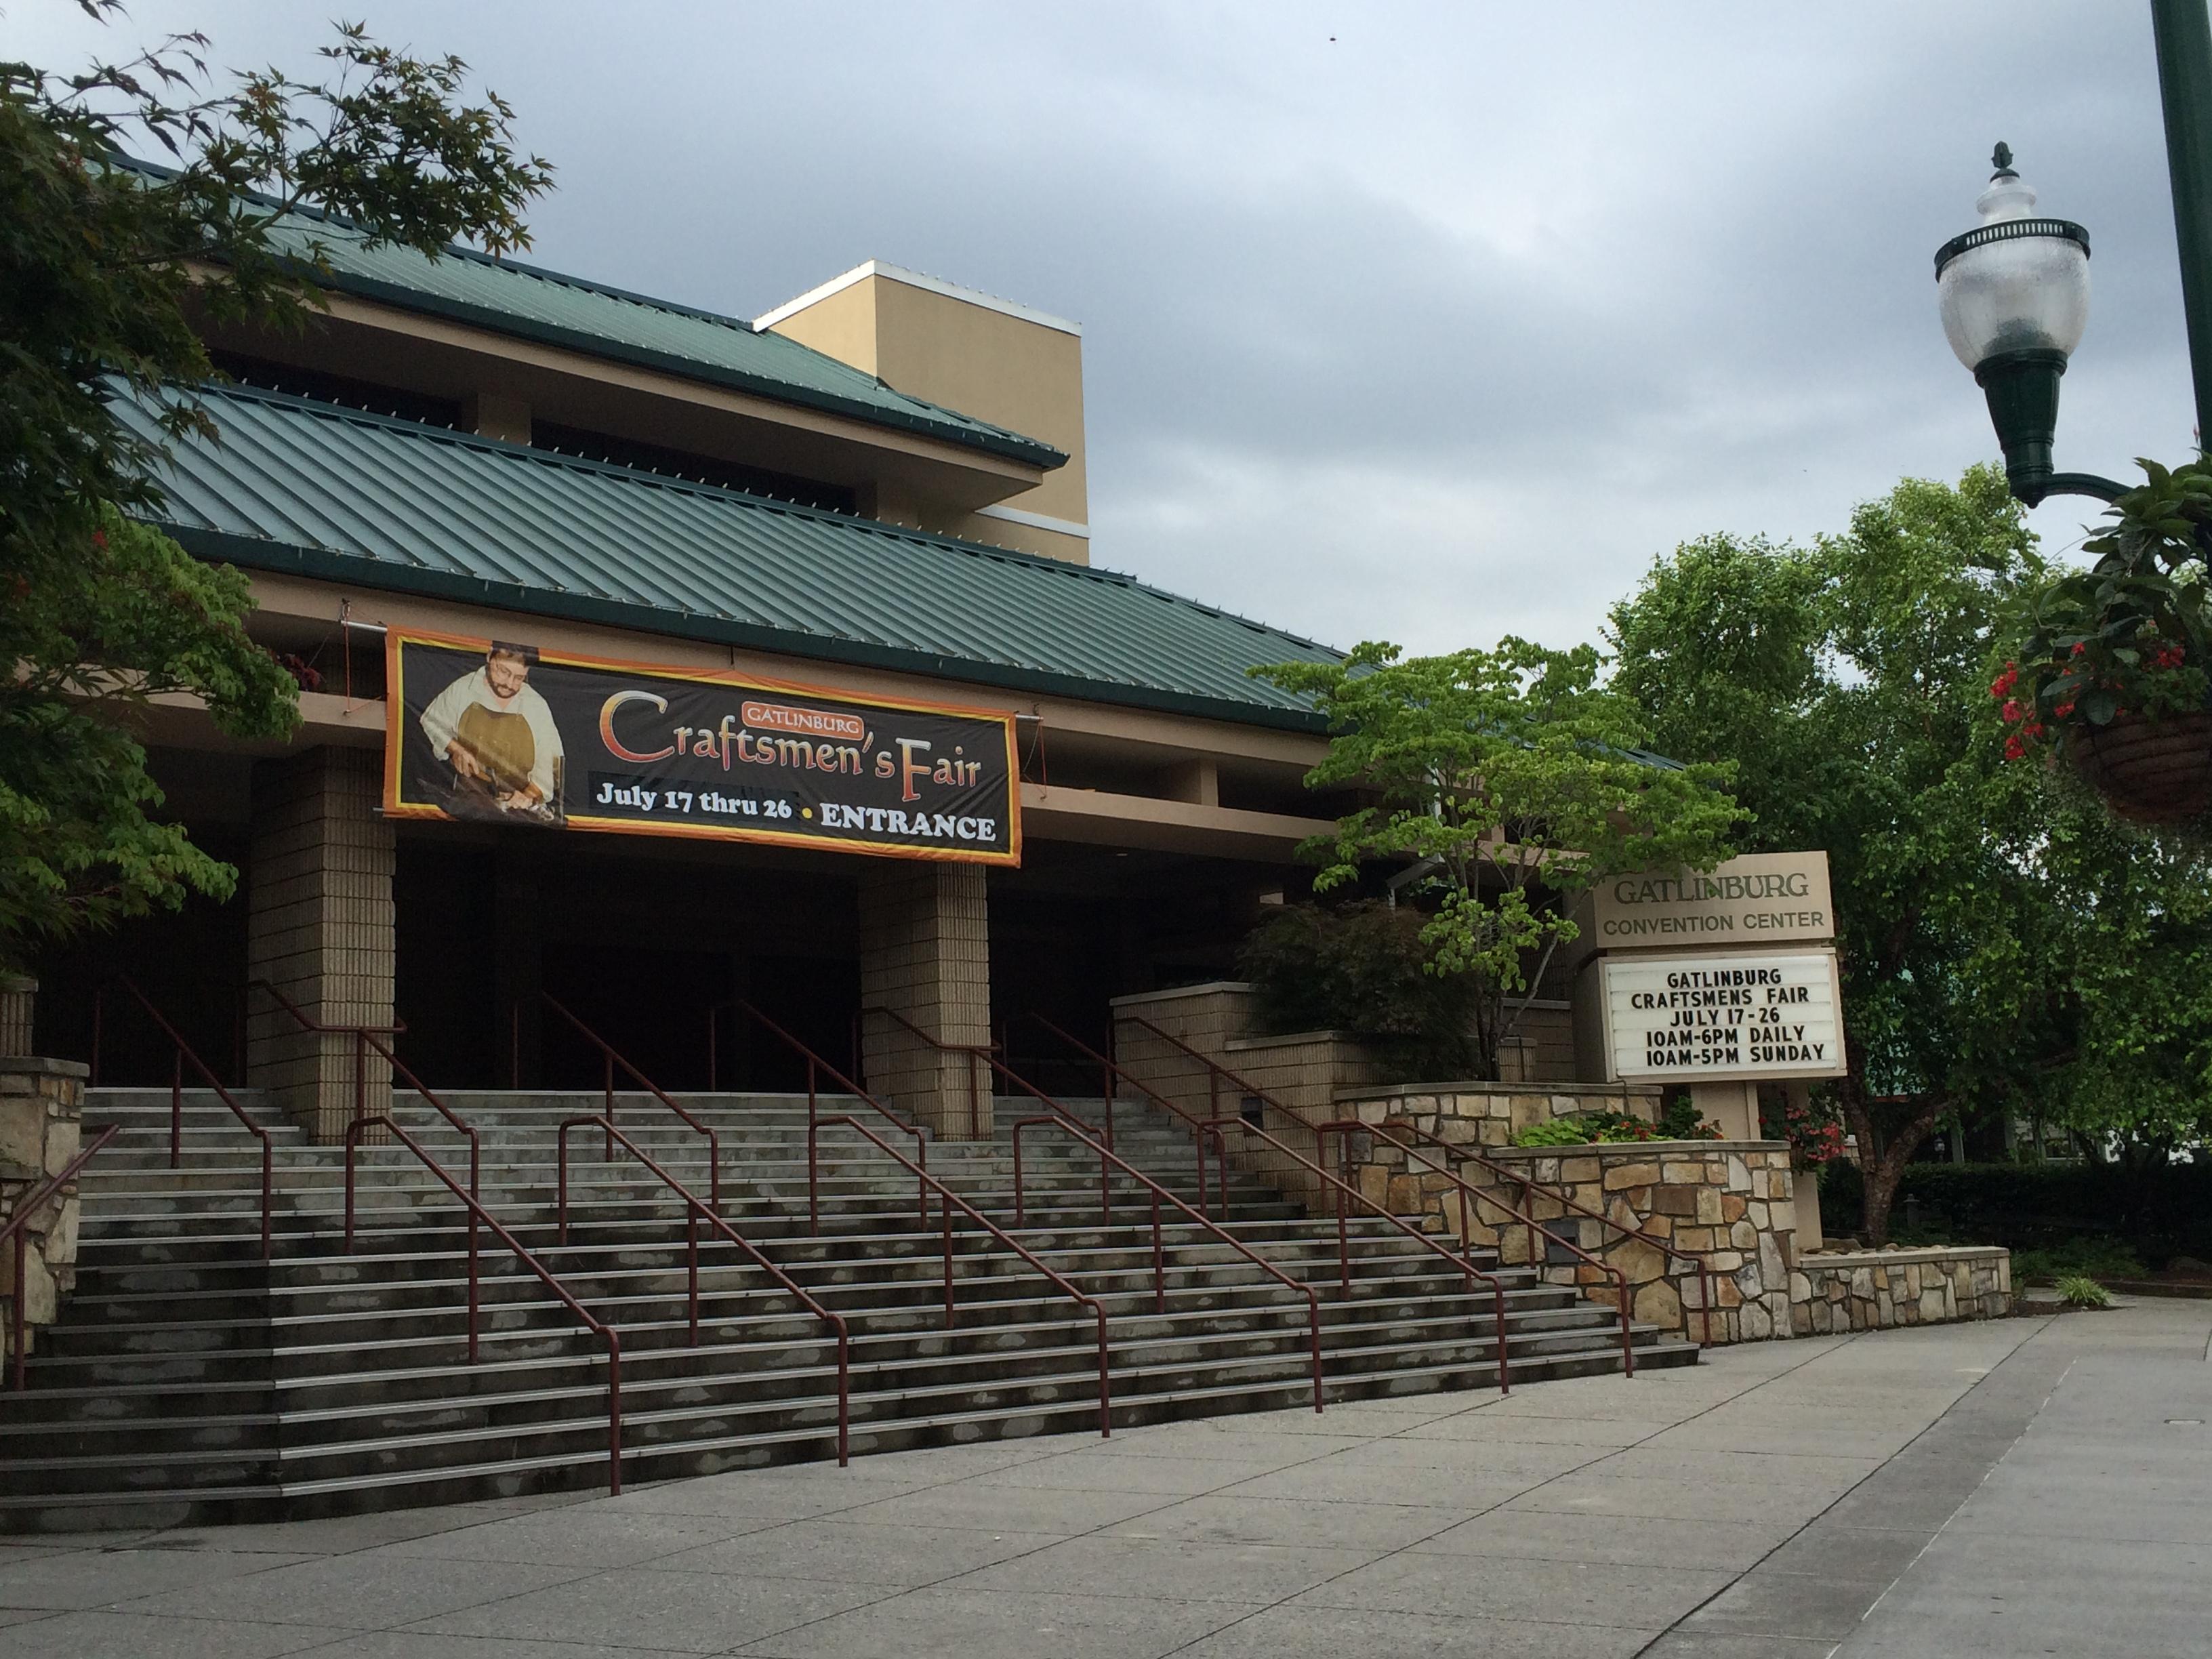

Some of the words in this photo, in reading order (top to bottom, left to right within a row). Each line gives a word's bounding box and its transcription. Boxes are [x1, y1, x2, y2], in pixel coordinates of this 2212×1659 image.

[747, 705, 859, 735] GATLINBURG
[599, 690, 895, 779] Craftsmen's
[895, 737, 982, 802] Fair
[596, 783, 657, 812] July
[664, 791, 693, 813] 17
[701, 791, 758, 815] thru
[764, 799, 792, 819] 26
[819, 802, 997, 842] ENTRANCE
[1614, 873, 1809, 904] GATLINBURG
[1603, 915, 1734, 935] CONVENTION
[1743, 912, 1824, 929] CENTER
[1667, 968, 1782, 988] GATLINBURG
[1631, 989, 1753, 1008] CRAFTSMENS
[1767, 987, 1809, 1004] FAIR
[1670, 1009, 1719, 1027] JULY
[1647, 1028, 1738, 1047] 10AM-6PM
[1750, 1025, 1805, 1043] DAILY
[1647, 1047, 1739, 1066] 10AM-5PM
[1750, 1044, 1824, 1062] SUNDAY
